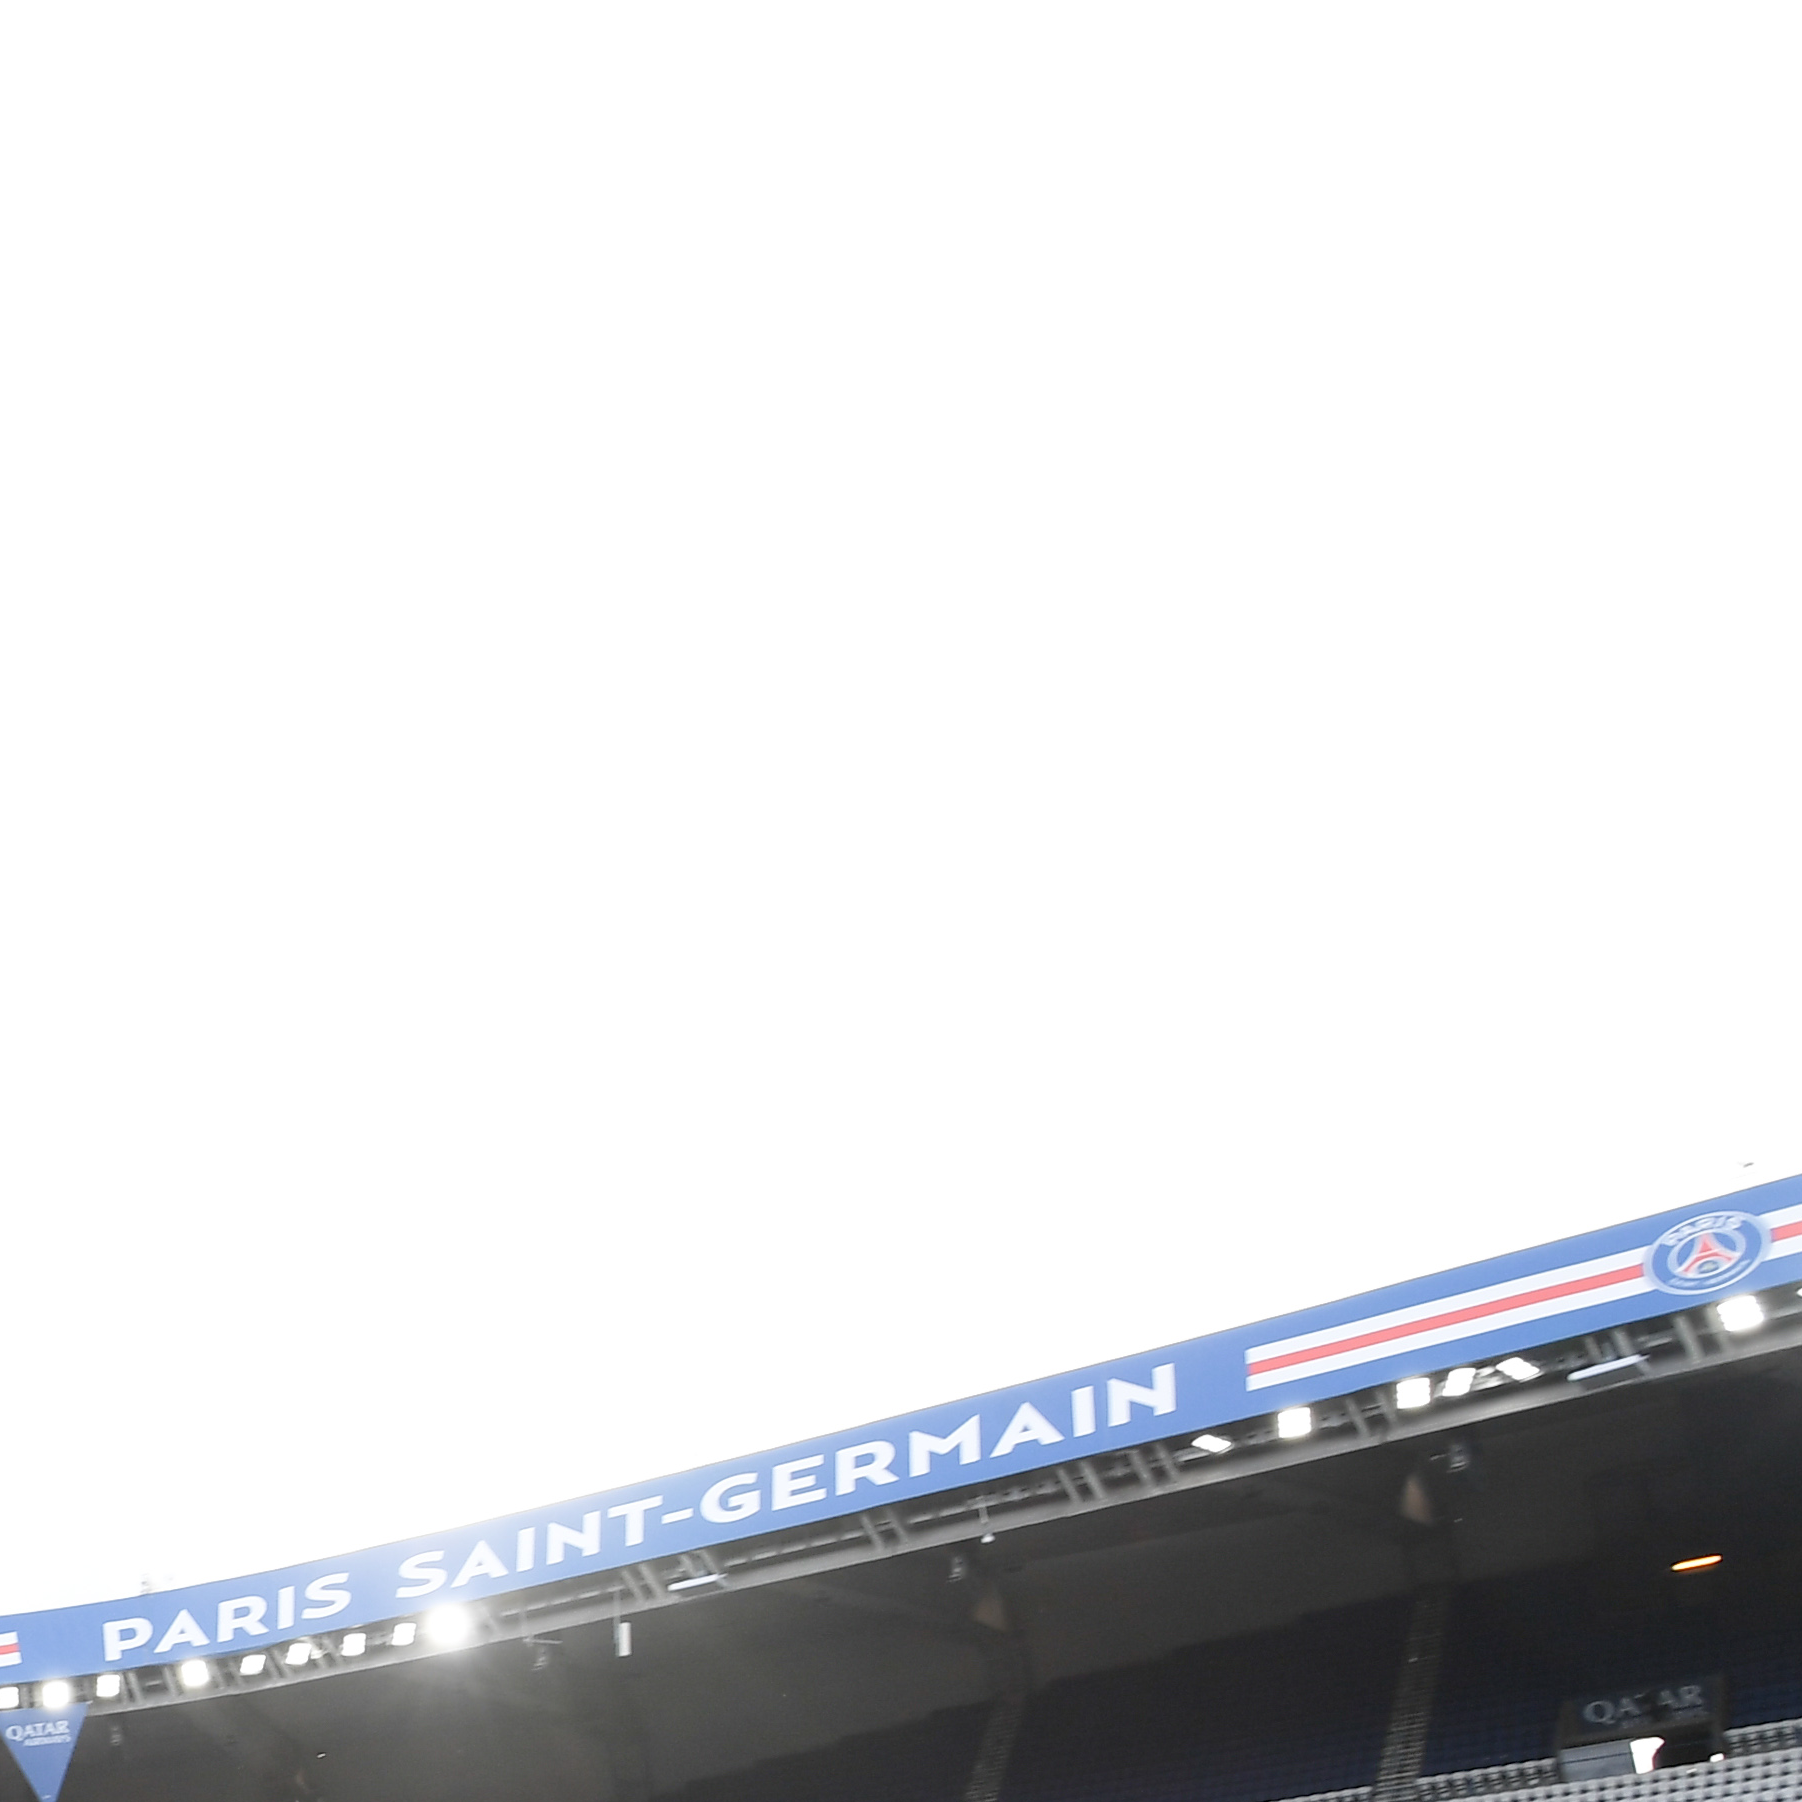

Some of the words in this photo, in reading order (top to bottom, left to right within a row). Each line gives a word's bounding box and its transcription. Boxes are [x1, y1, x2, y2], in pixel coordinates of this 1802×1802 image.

[101, 1571, 352, 1661] PARIS
[396, 1362, 1178, 1598] SAINT-GERMAIN
[1583, 1684, 1703, 1725] QAAR
[5, 1720, 70, 1742] QATAR
